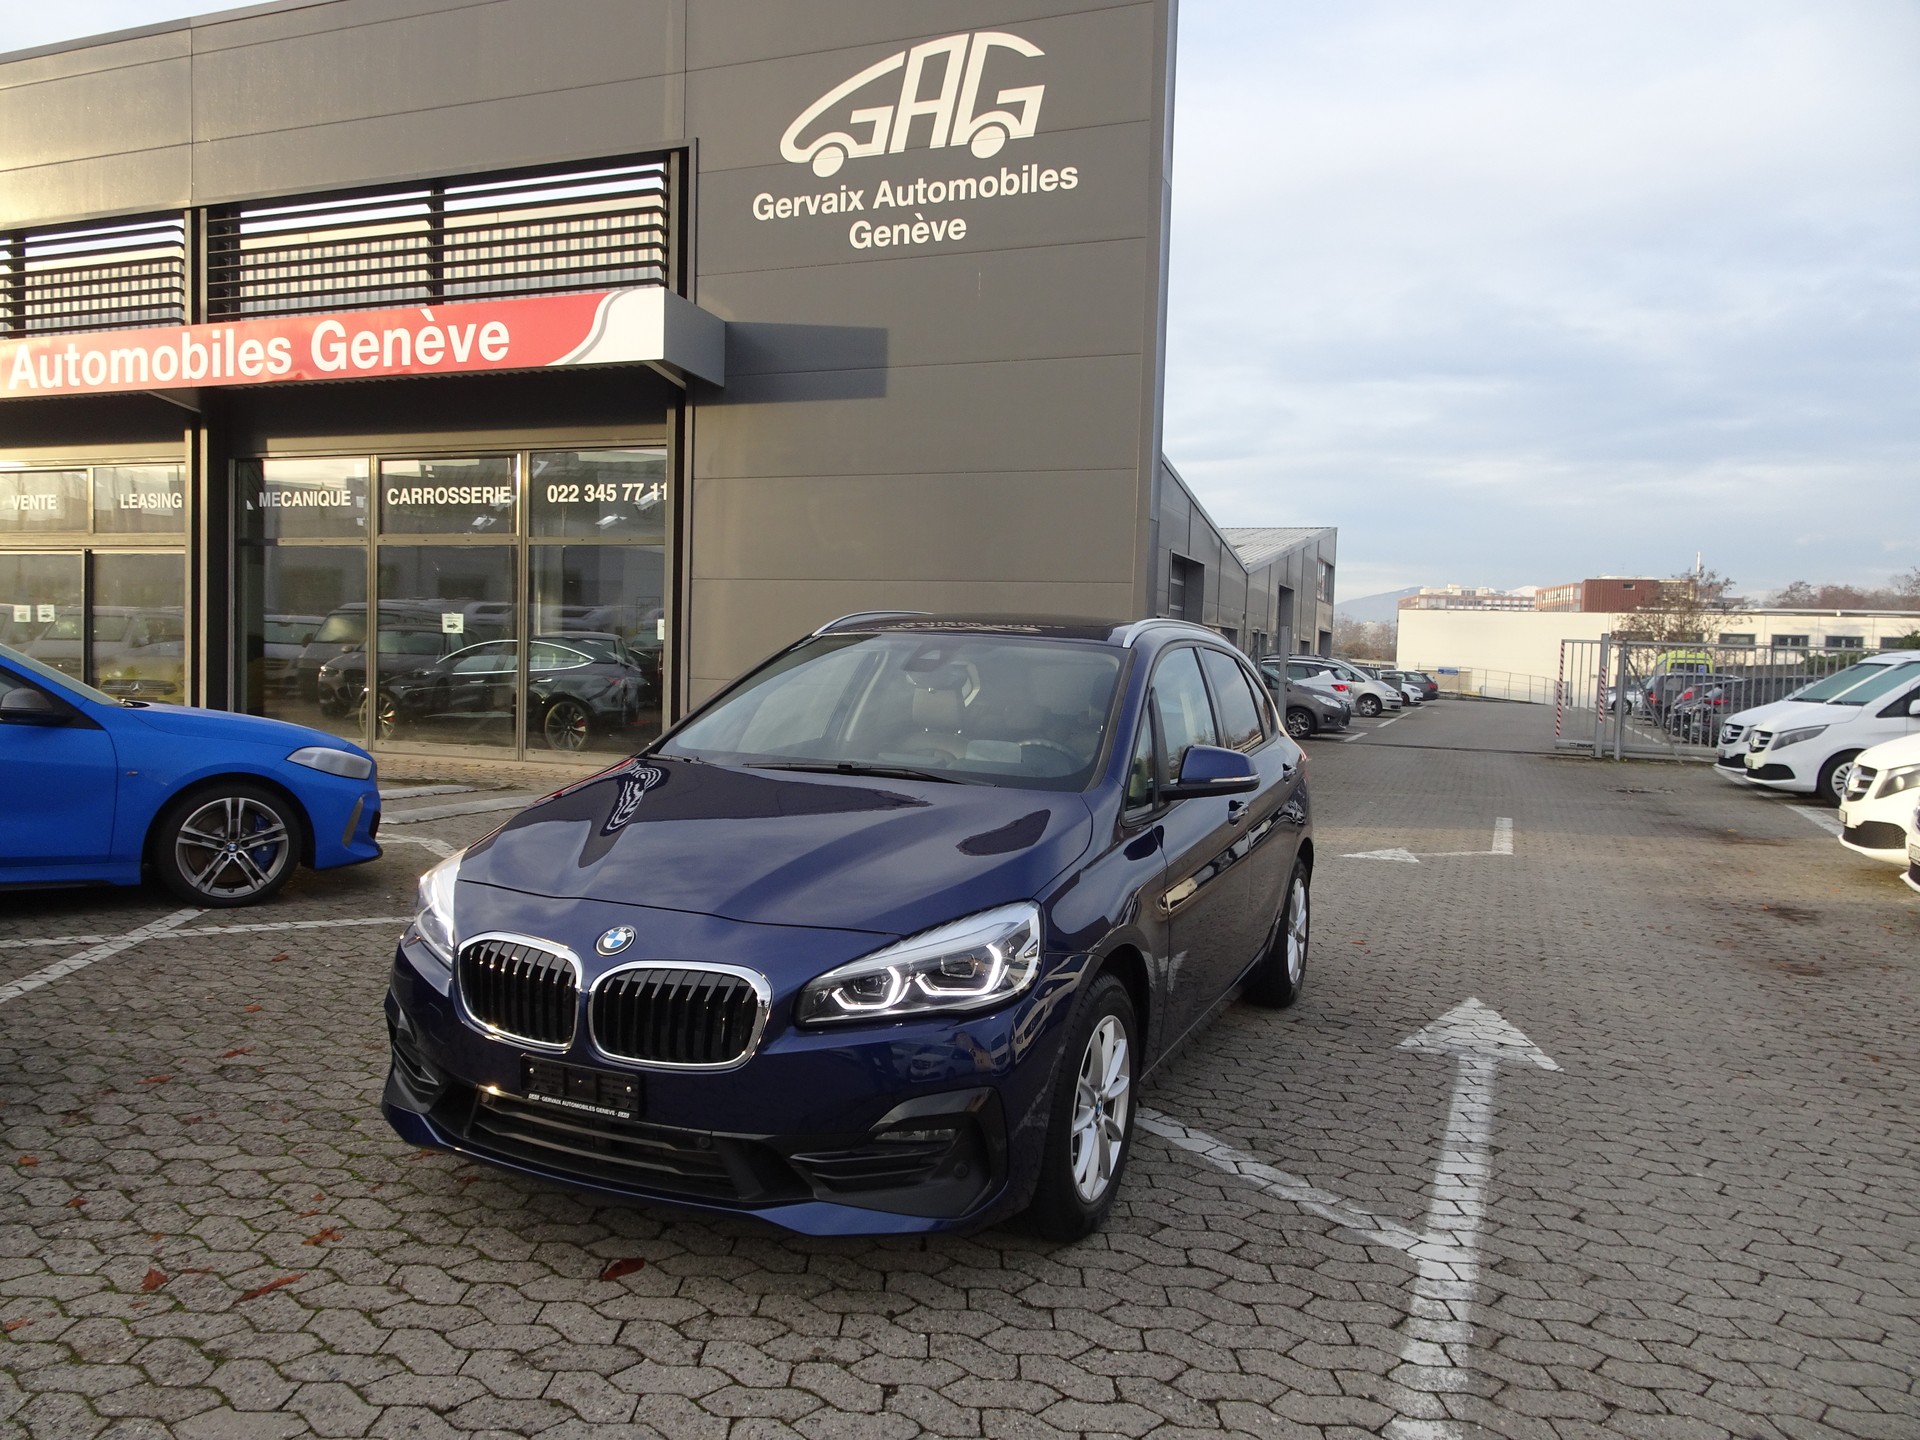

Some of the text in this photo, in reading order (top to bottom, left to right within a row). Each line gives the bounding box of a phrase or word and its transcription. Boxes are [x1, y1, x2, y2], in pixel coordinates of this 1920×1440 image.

[752, 163, 1079, 221] Gervaix Automobiles
[849, 212, 967, 249] Genève
[7, 308, 511, 391] Automobiles Genève
[11, 494, 57, 511] VENTE
[119, 492, 183, 509] LEASING
[258, 490, 352, 508] MECANIQUE
[386, 486, 512, 506] CARROSSERIE
[546, 481, 668, 503] 022 345 77 11
